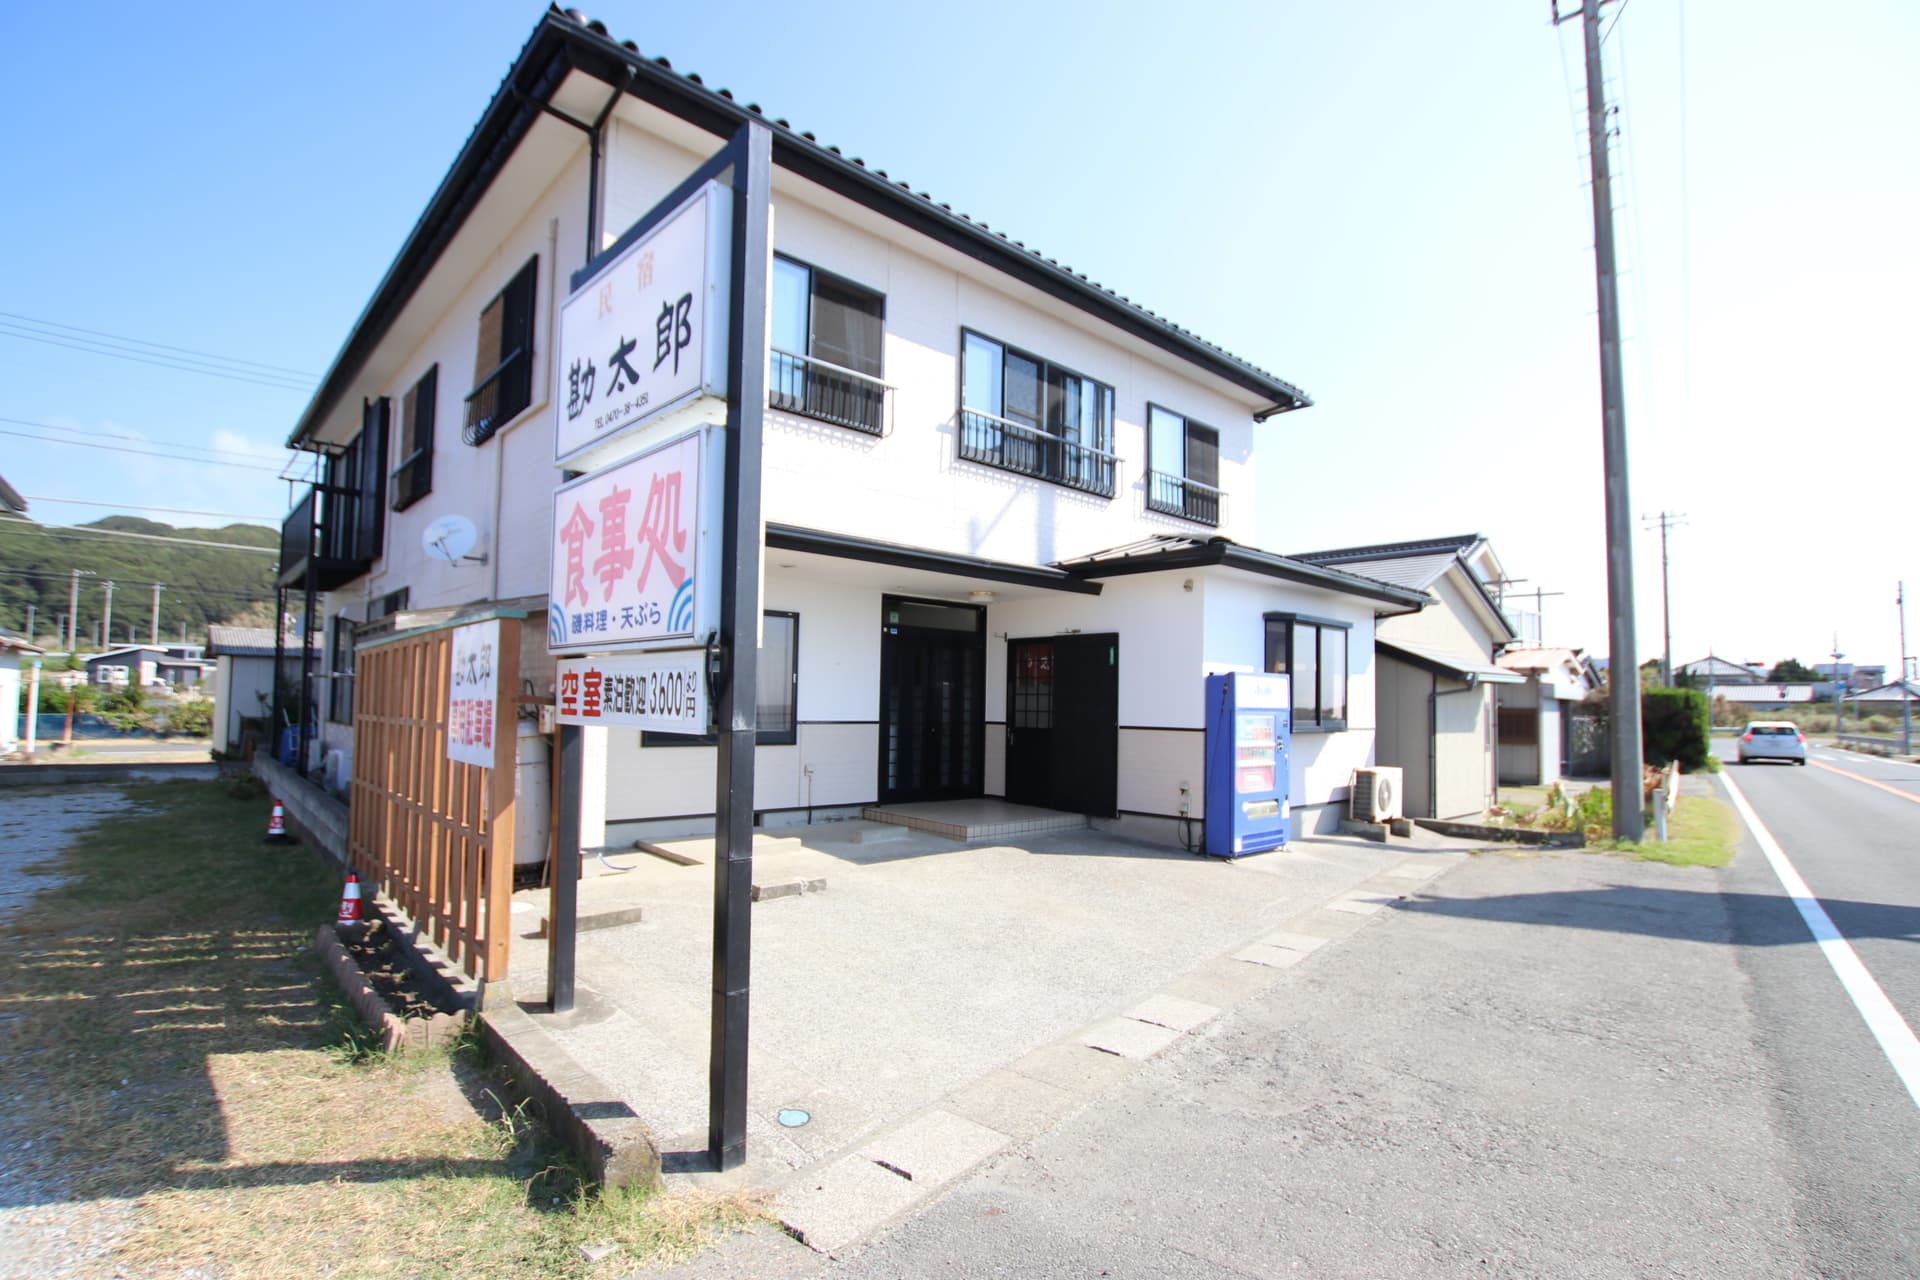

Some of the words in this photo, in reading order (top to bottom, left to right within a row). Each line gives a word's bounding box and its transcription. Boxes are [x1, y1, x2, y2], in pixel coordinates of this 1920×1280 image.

[599, 252, 654, 319] 民宿
[567, 292, 693, 421] 勘太郎
[560, 471, 687, 608] 食事処
[561, 667, 602, 717] 空室
